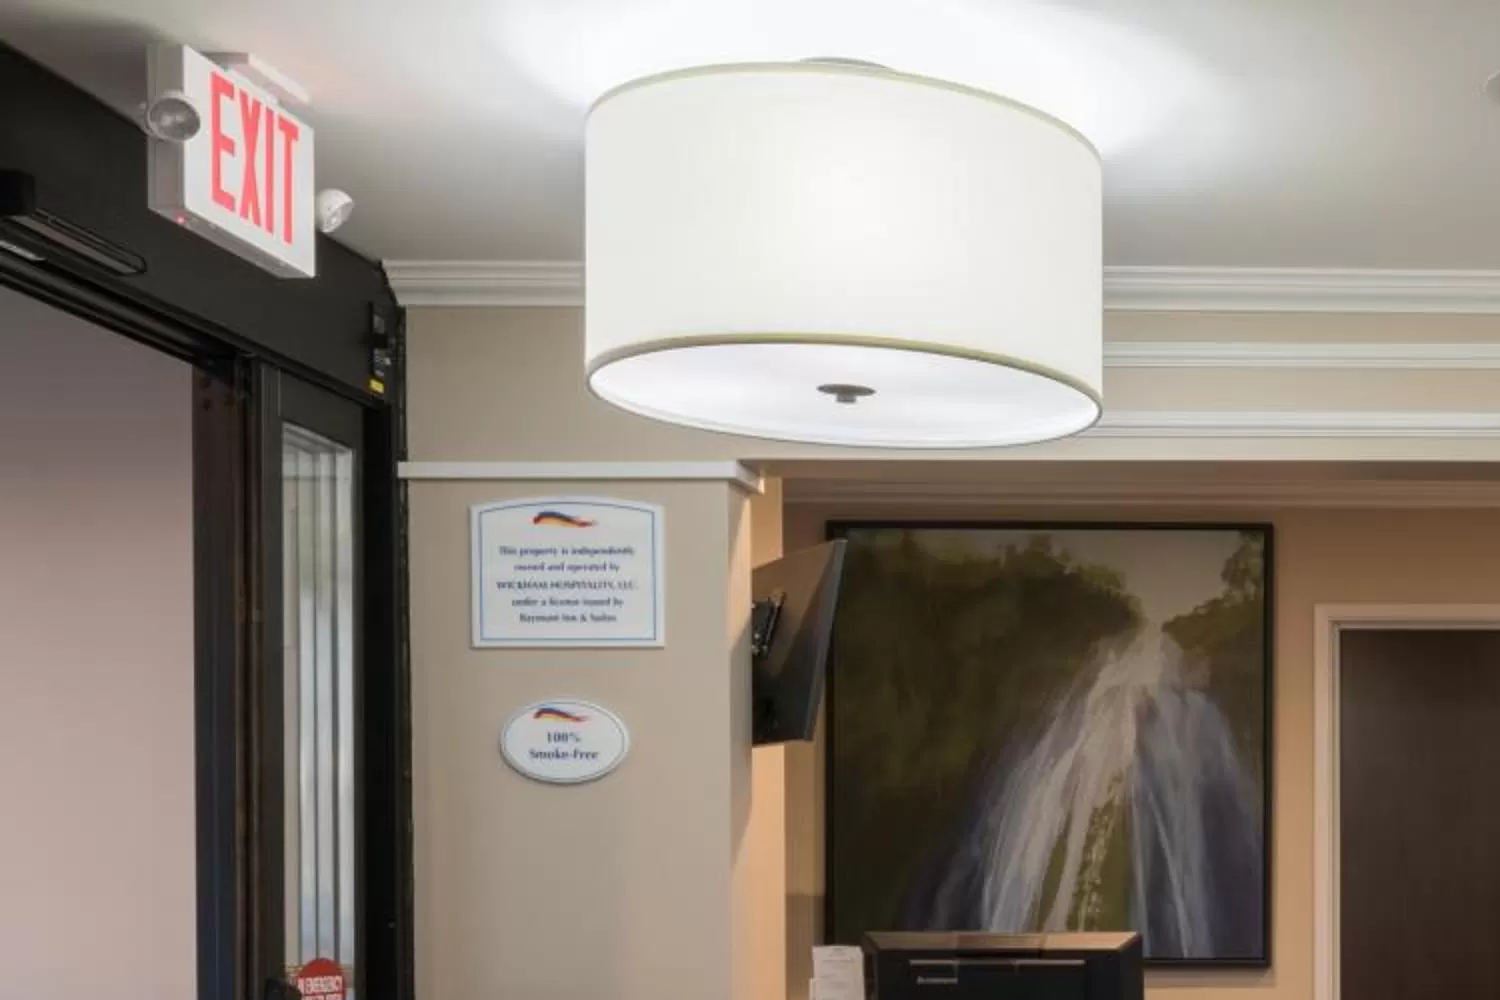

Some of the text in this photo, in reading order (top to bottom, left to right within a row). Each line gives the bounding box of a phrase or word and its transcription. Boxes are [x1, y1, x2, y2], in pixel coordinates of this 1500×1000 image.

[209, 70, 300, 246] EXIT
[519, 545, 558, 558] property
[571, 545, 634, 558] independently
[513, 560, 620, 573] owned and operated by
[512, 596, 538, 607] under
[548, 596, 580, 607] license
[583, 596, 610, 607] issued
[613, 596, 624, 608] by
[519, 612, 559, 624] Baymont
[561, 613, 577, 622] Inn
[589, 613, 617, 622] Suites
[547, 731, 582, 744] 100%
[528, 748, 599, 760] Smoke-Free
